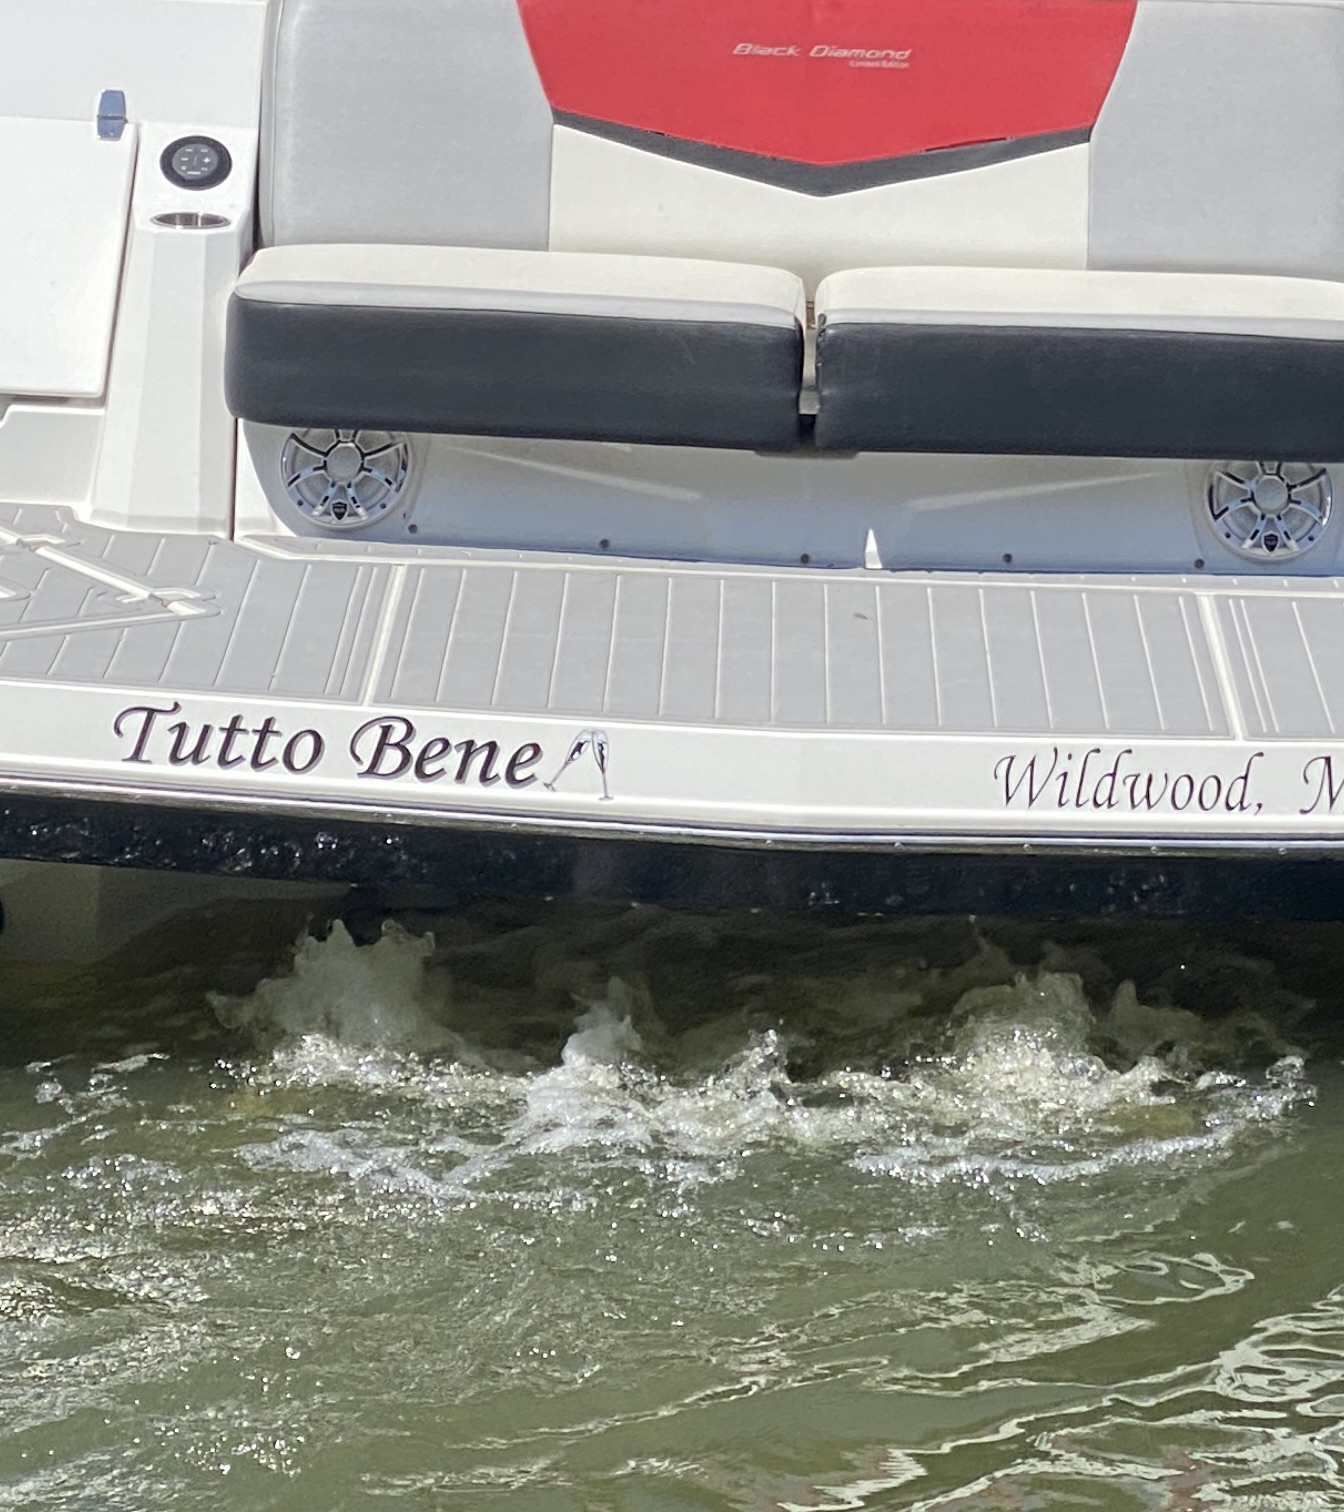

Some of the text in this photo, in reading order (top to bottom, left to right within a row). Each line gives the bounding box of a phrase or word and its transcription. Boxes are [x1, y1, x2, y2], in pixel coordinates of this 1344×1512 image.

[732, 43, 912, 60] Black Diamond
[112, 700, 544, 788] Tutto Bene
[993, 746, 1265, 816] Wildwood,
